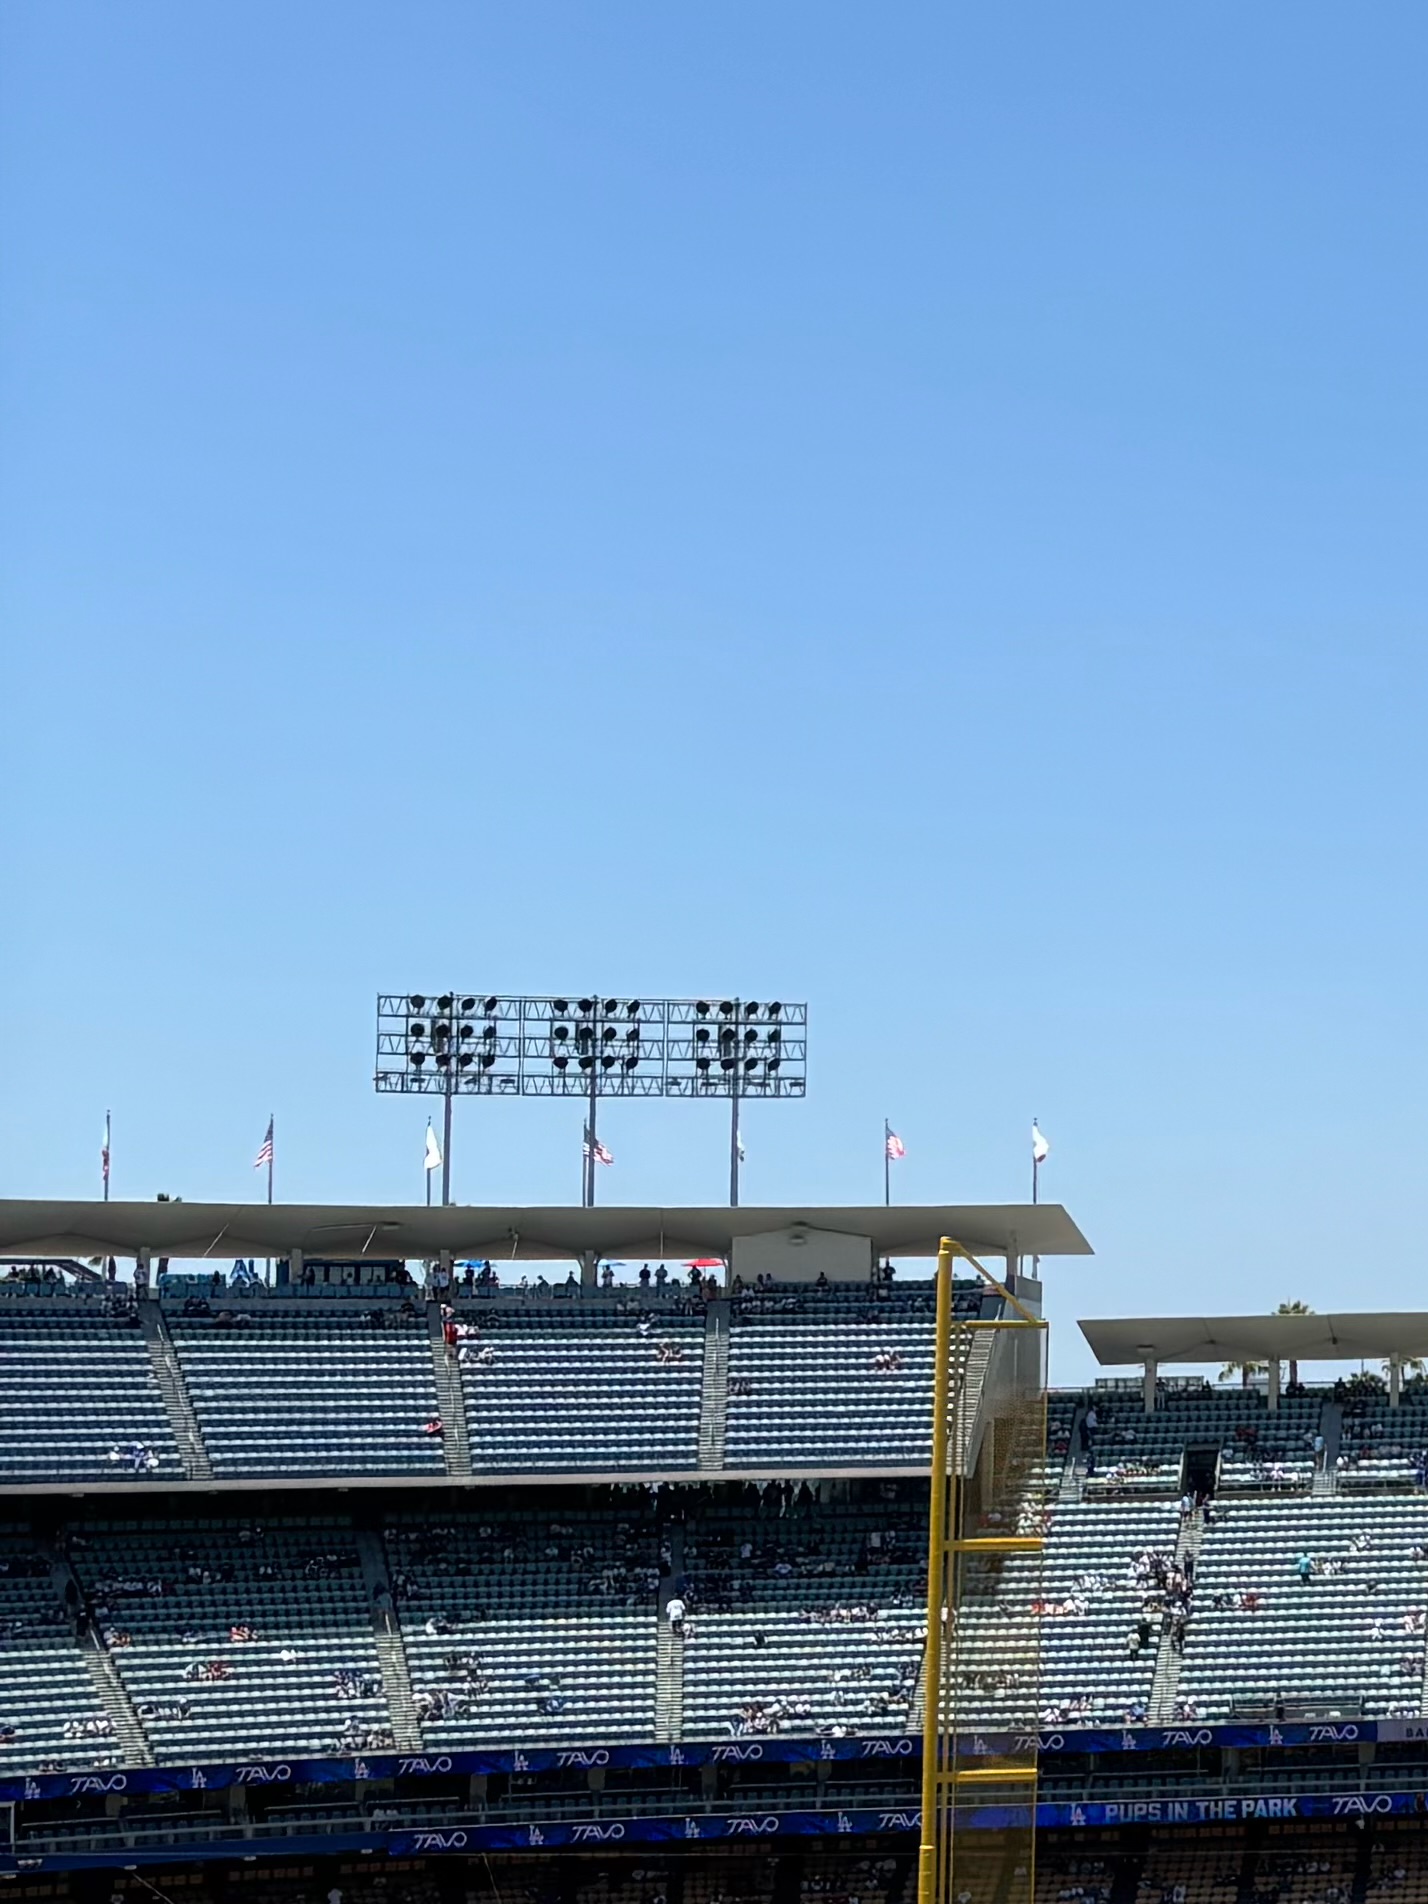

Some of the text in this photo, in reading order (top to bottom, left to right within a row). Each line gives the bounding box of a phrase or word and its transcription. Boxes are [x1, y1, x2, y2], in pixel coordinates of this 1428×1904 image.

[1162, 1729, 1212, 1746] TAVO
[1309, 1724, 1358, 1742] TAVO
[712, 1744, 763, 1761] TAVO
[862, 1739, 912, 1756] TAVO
[399, 1756, 452, 1774] TAVO
[556, 1749, 610, 1767] TAVO
[235, 1764, 291, 1783] TAVO
[71, 1774, 127, 1793] TAVO
[1105, 1798, 1297, 1823] PUPS IN THE PARK
[1332, 1795, 1392, 1815] TAVO
[571, 1823, 625, 1841] TAVO
[727, 1816, 779, 1834] TAVO
[413, 1831, 467, 1848] TAVO
